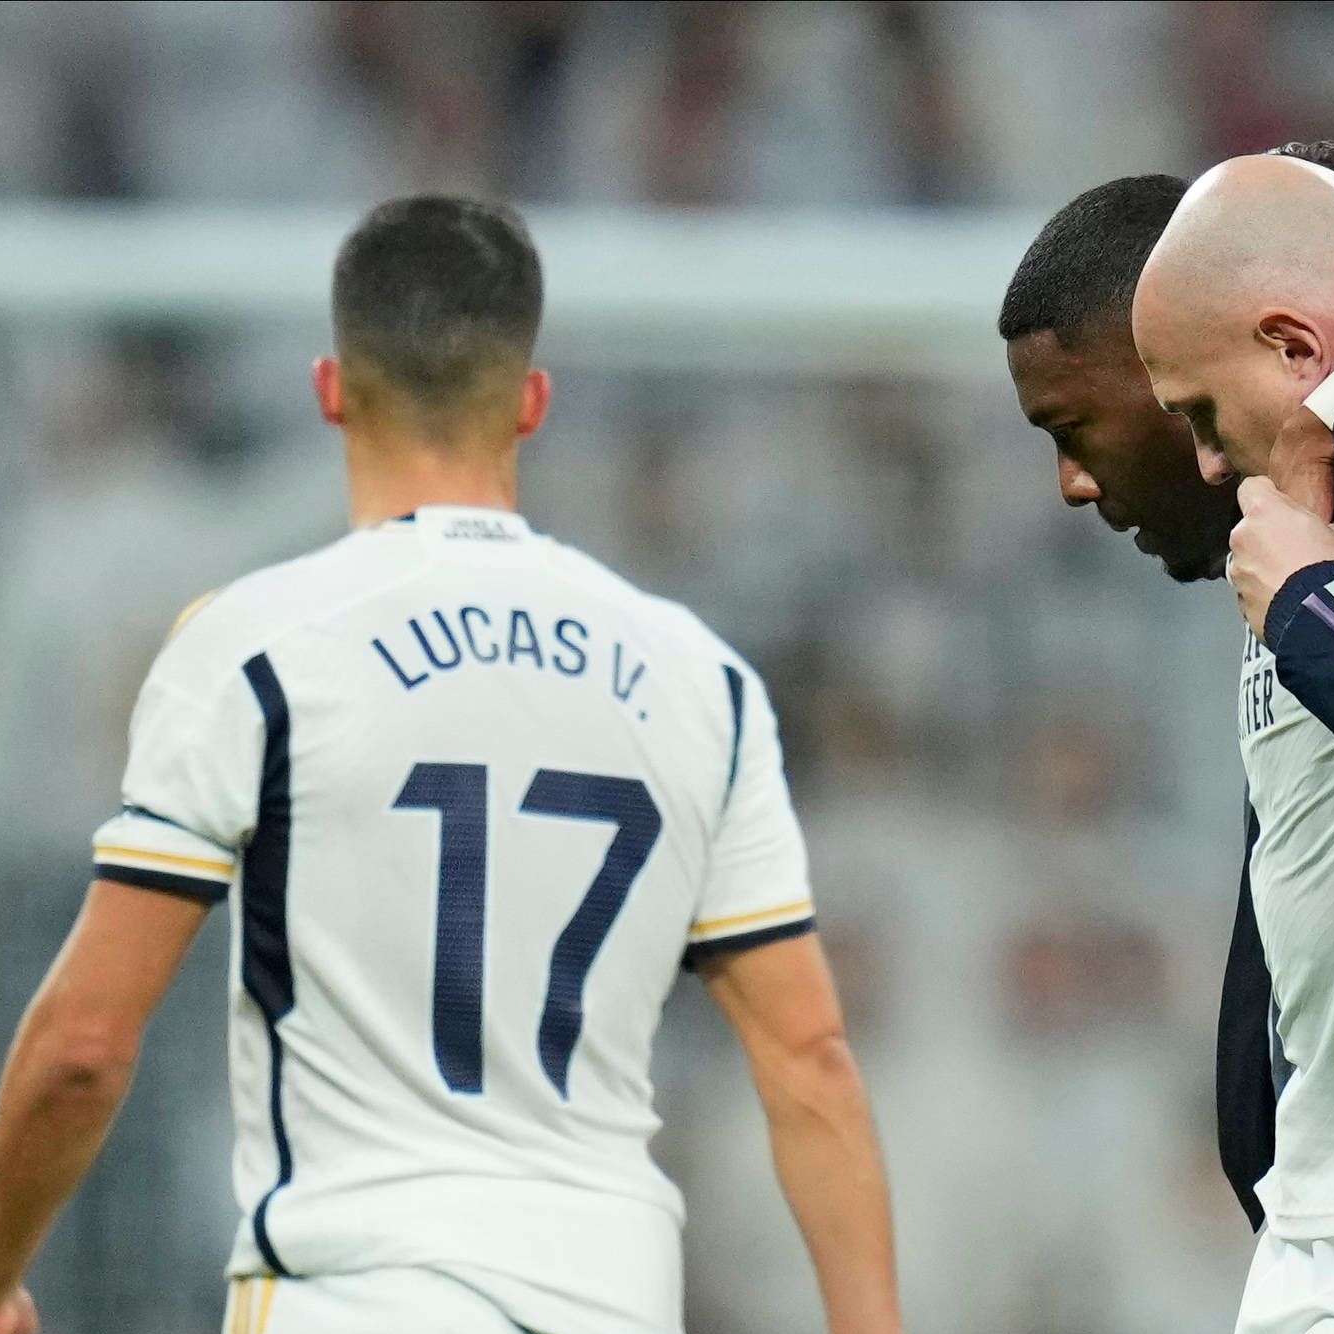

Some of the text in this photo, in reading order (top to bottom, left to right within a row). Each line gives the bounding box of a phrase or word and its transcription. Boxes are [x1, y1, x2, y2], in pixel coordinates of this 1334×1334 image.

[371, 605, 648, 721] LUCAS V.
[388, 761, 663, 1103] 17
